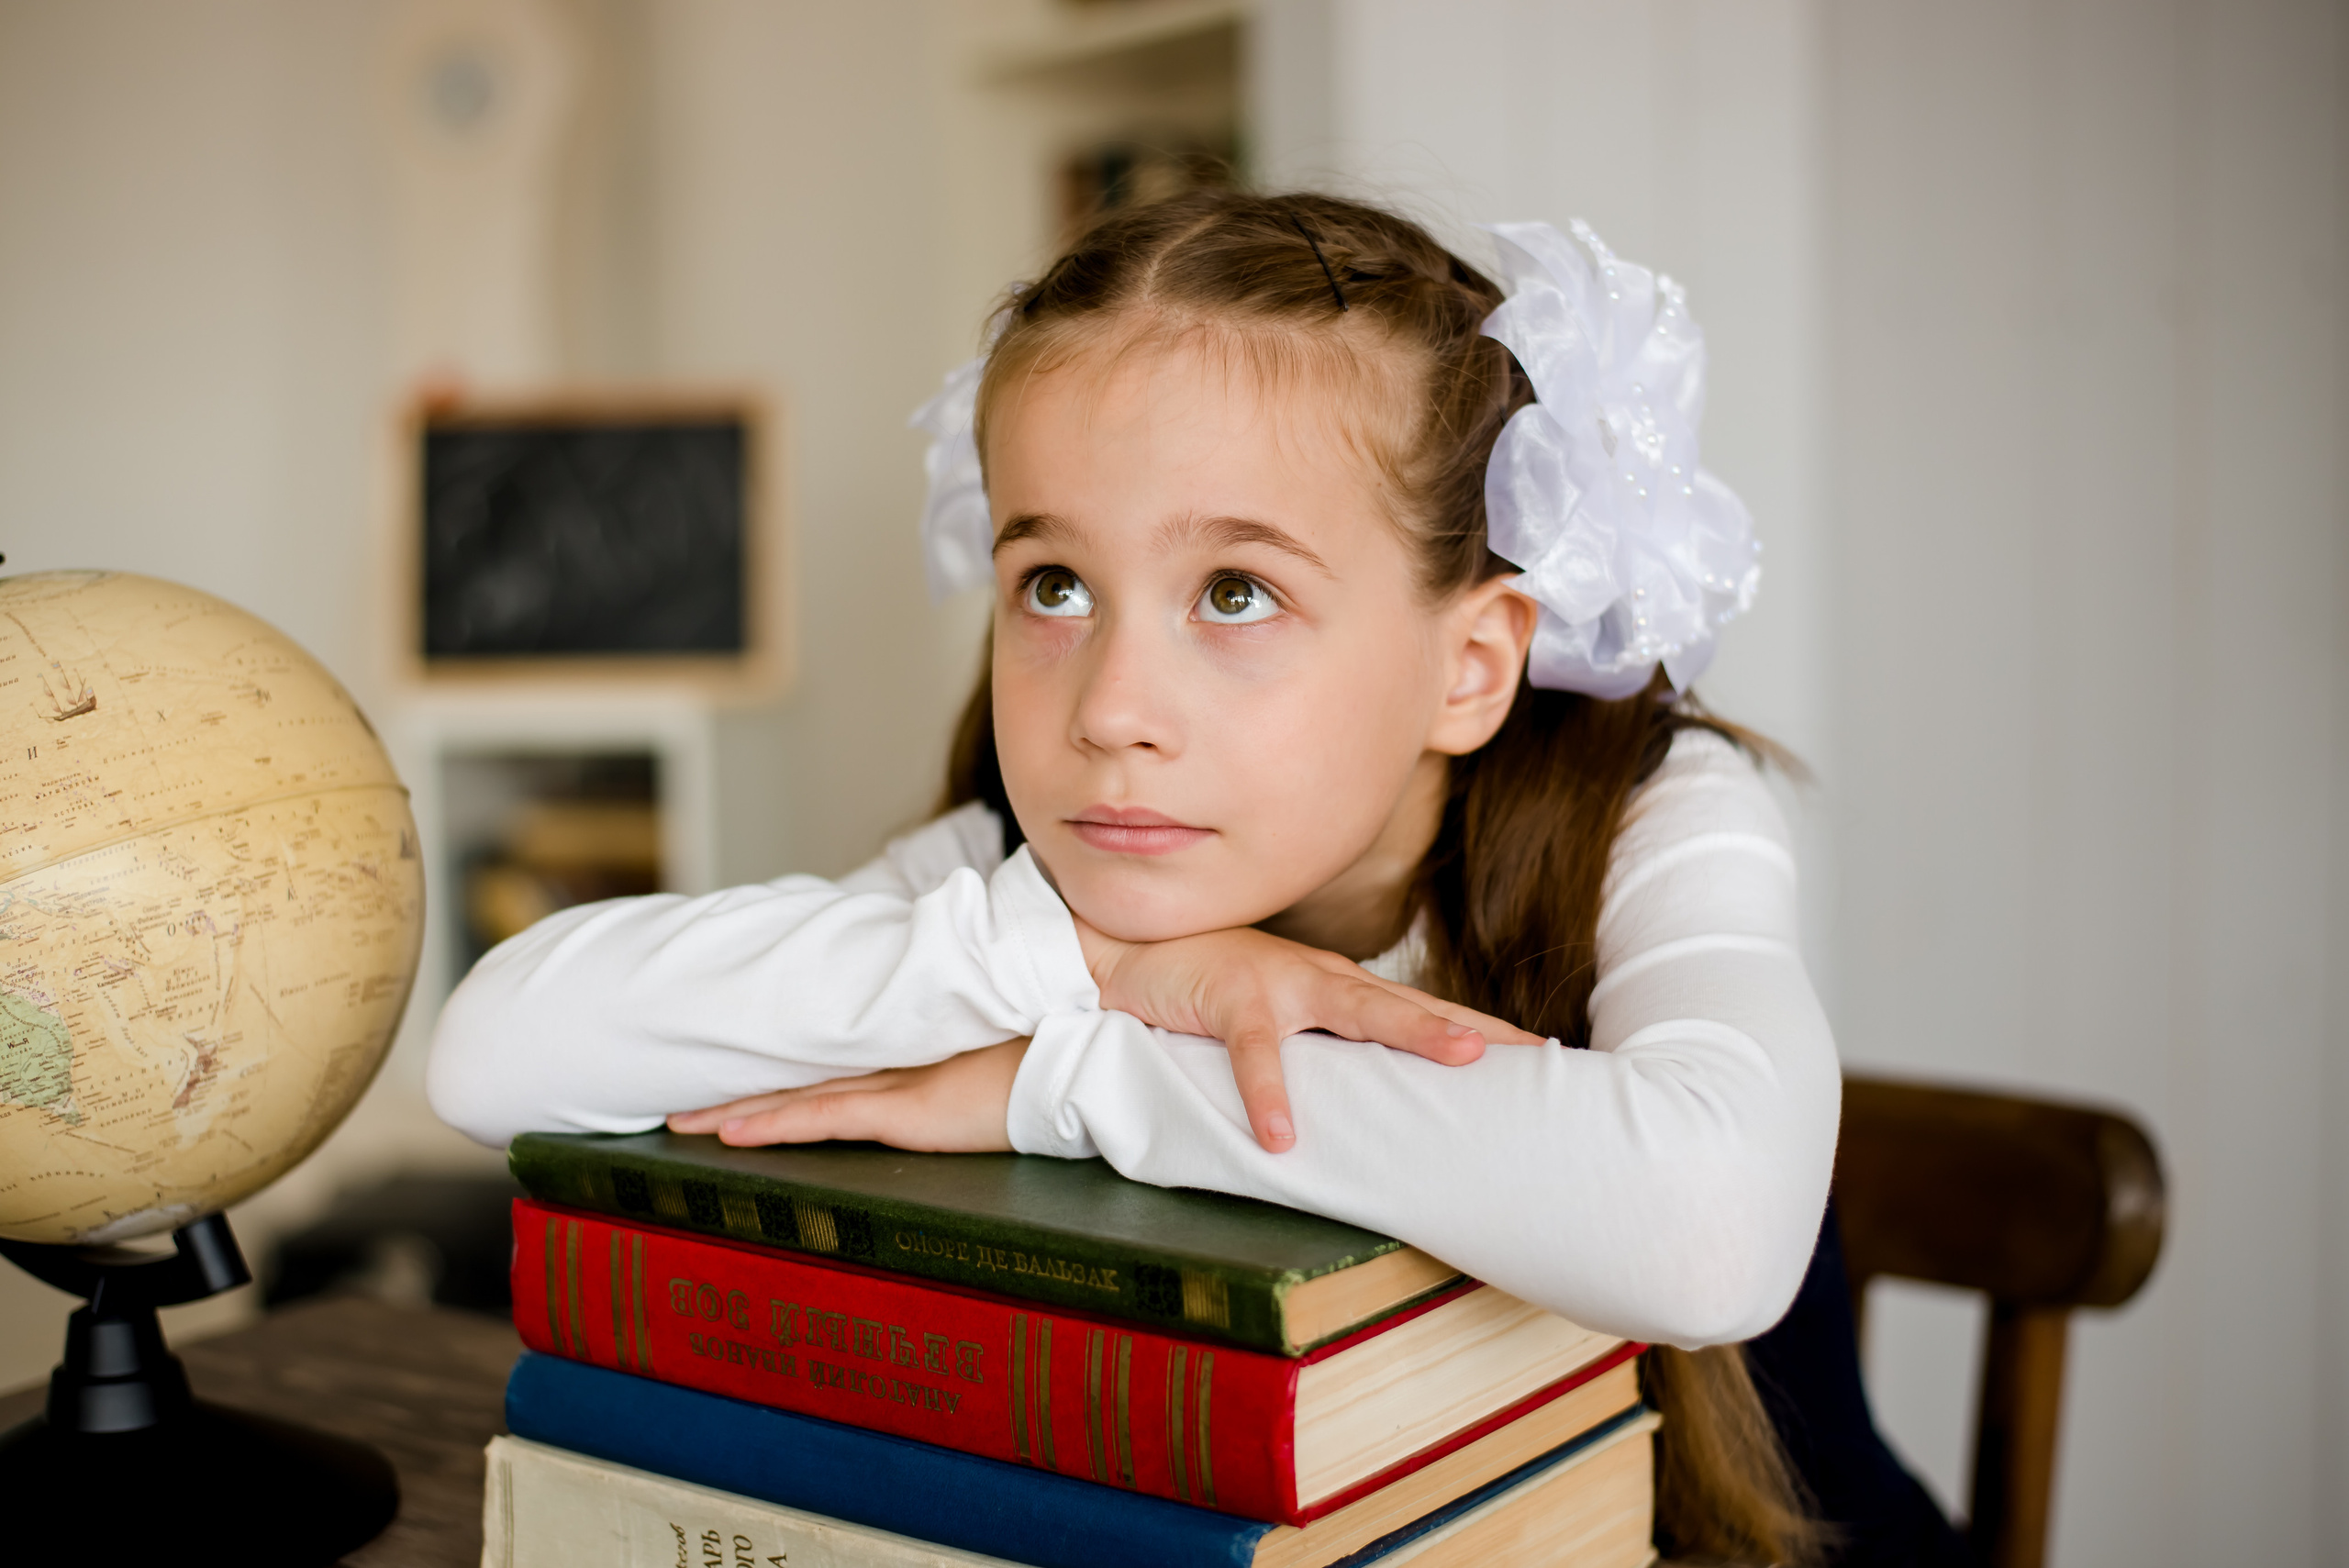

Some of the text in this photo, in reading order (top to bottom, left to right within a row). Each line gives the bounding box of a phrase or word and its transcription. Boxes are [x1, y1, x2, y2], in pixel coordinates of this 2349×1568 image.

[896, 1231, 1120, 1292] ОНОРЕ ДЕ БАЛЬЗАК
[668, 1277, 984, 1384] ВЕЧНЫЙ ЗОВ
[689, 1333, 962, 1414] АНАТОЛИЙ ИВАНОВ
